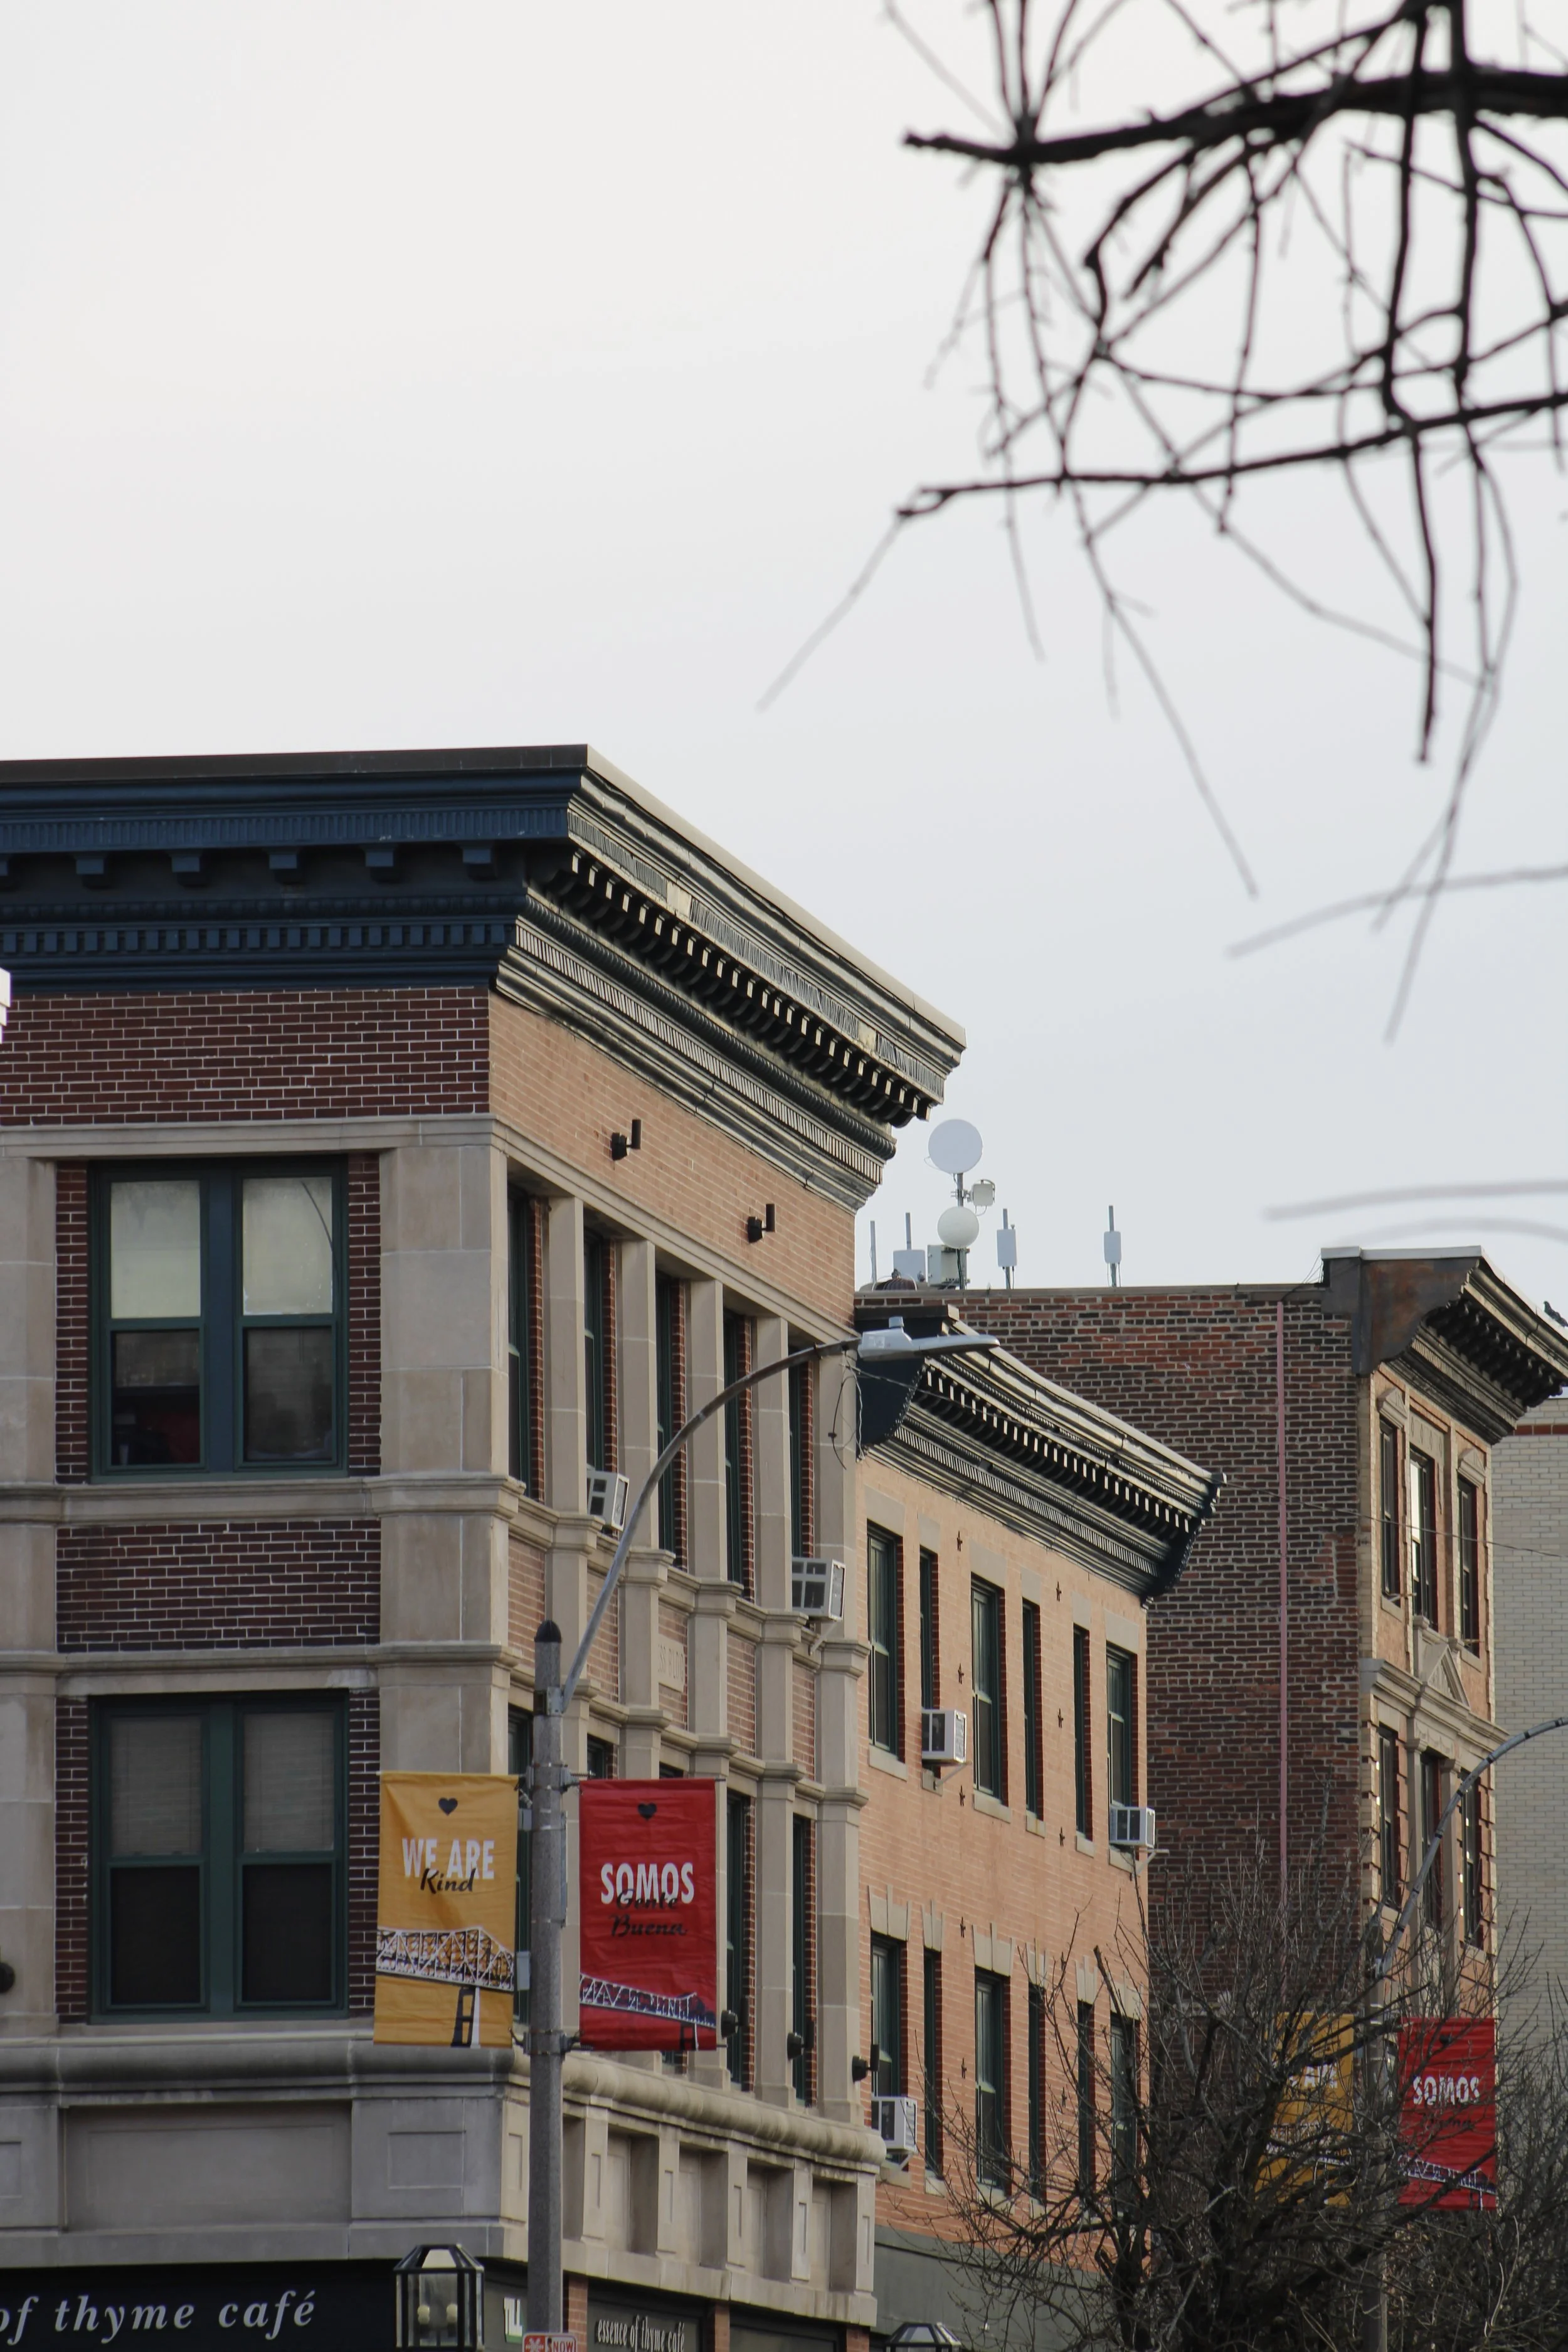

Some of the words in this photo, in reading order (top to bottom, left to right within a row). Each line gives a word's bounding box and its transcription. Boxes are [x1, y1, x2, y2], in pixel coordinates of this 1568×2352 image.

[402, 1838, 437, 1878] WE
[446, 1838, 494, 1879] ARE
[420, 1868, 476, 1894] Kind
[601, 1862, 694, 1904] SOMOS
[617, 1888, 678, 1909] Gente
[609, 1914, 687, 1937] Buena
[1413, 2076, 1480, 2106] SOMOS
[55, 2294, 194, 2344] thyme
[218, 2290, 315, 2340] café
[598, 2319, 627, 2346] essence
[630, 2314, 640, 2352] of
[641, 2316, 665, 2352] thyme
[668, 2321, 685, 2352] café
